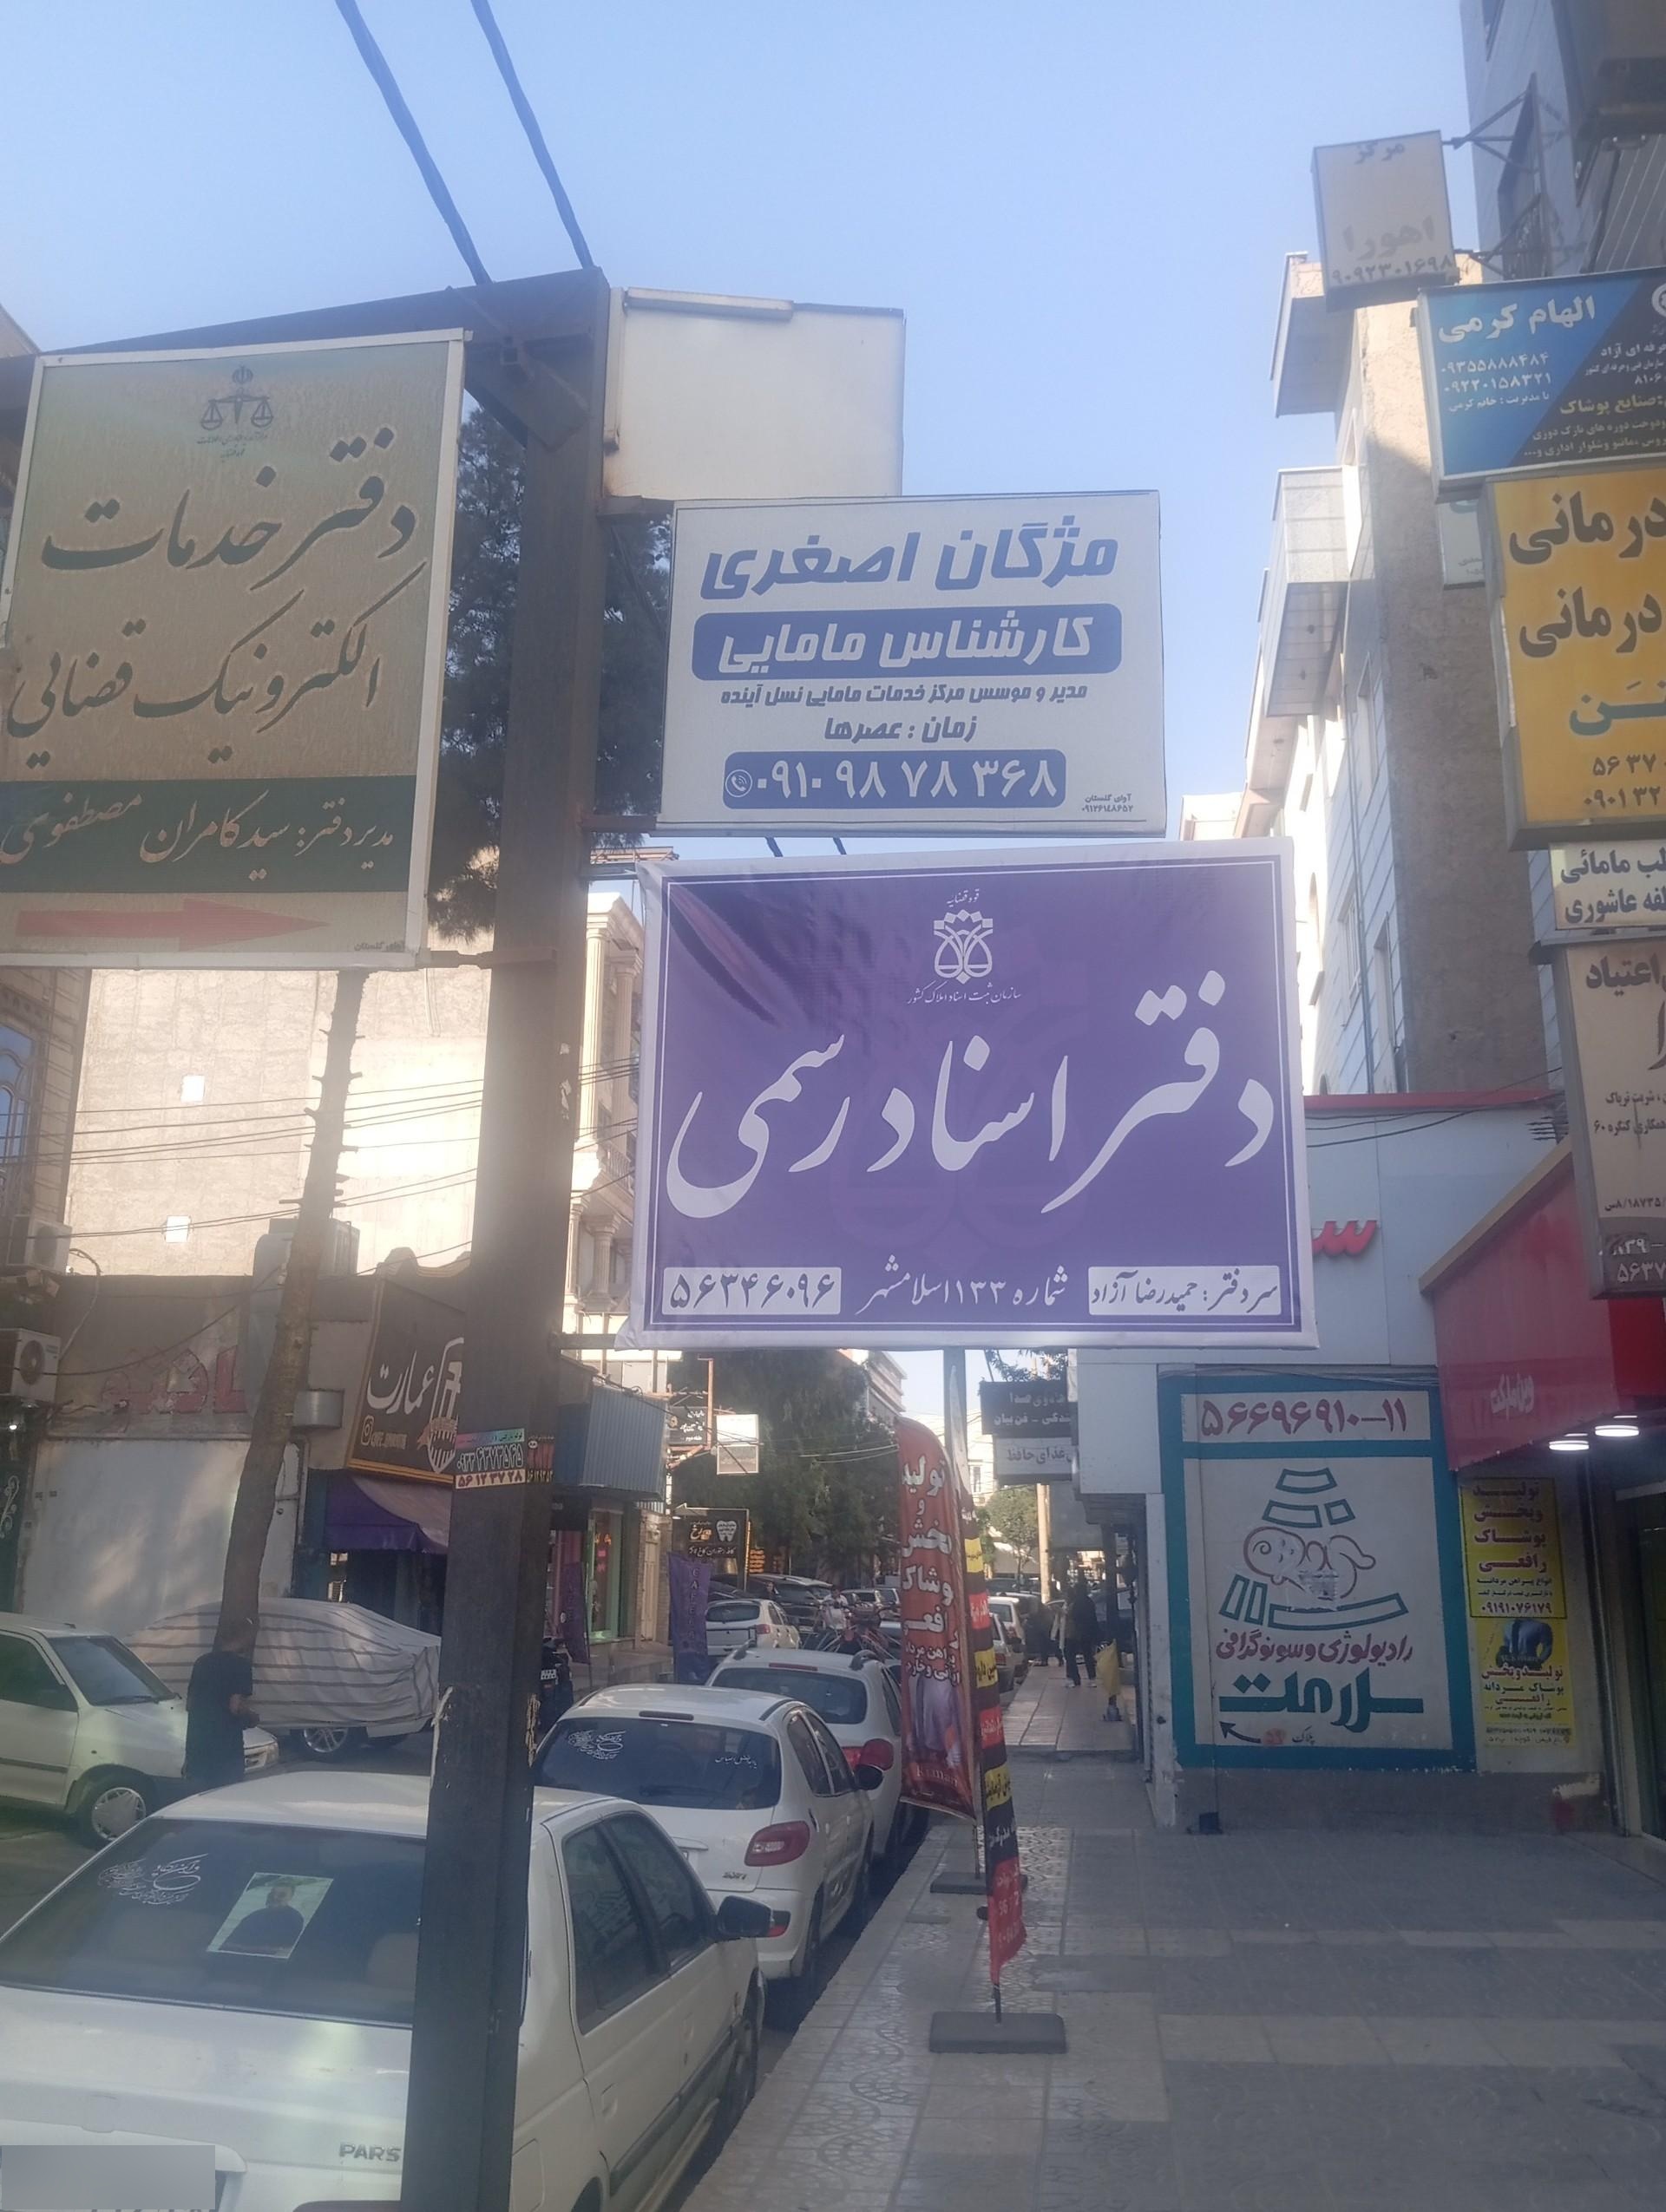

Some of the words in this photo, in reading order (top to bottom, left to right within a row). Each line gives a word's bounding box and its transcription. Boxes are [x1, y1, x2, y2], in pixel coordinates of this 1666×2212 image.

[1439, 303, 1518, 344] کرمی
[1528, 295, 1596, 336] الهام
[1560, 398, 1610, 416] پوشاک
[41, 465, 284, 573] خدمات
[251, 426, 416, 592] دفتر
[1510, 490, 1666, 565] درمانی
[700, 531, 922, 601] اصغری
[935, 515, 1118, 592] مژگان
[878, 610, 1094, 669] کارشناس
[1519, 586, 1663, 658] درمانی
[133, 560, 428, 764] الکترونیک
[718, 622, 866, 675] مامایی
[720, 683, 764, 709] آینده
[764, 685, 804, 707] نسل
[805, 684, 863, 708] مامایی
[865, 684, 927, 703] خدمات
[928, 683, 965, 704] مرکز
[968, 685, 1033, 704] موسس
[1035, 685, 1046, 704] و
[1049, 684, 1089, 704] مدیر
[824, 717, 903, 745] عصرها
[921, 715, 978, 744] زمان
[757, 760, 823, 800] ۰۹۱۰
[837, 758, 887, 799] ۹۸
[901, 758, 958, 798] ۷۸
[972, 757, 1058, 798] ۳۶۸
[1085, 793, 1112, 804] گلستان
[1113, 792, 1131, 804] آوای
[0, 791, 142, 864] مصطفوی
[140, 789, 270, 863] کامران
[237, 823, 290, 880] سید
[354, 824, 393, 870] مدیر
[1561, 848, 1631, 884] مامائی
[1564, 887, 1637, 924] عاشوری
[907, 979, 936, 1005] کشور
[989, 985, 1021, 1004] سازمان
[1586, 952, 1661, 997] اعتیاد
[867, 1035, 1069, 1173] اسناد
[1041, 970, 1275, 1214] دفتر
[666, 1033, 851, 1219] رسمی
[670, 1272, 836, 1309] ۵۶۳۴۶۰۹۶
[855, 1254, 951, 1316] اسلامشهر
[1012, 1265, 1069, 1306] شماره
[1091, 1269, 1139, 1305] آزاد
[366, 1348, 436, 1416] عمارت
[1473, 1528, 1547, 1548] پوشاک
[1317, 1630, 1413, 1667] رادیولوژی
[338, 2142, 403, 2163] PARS
